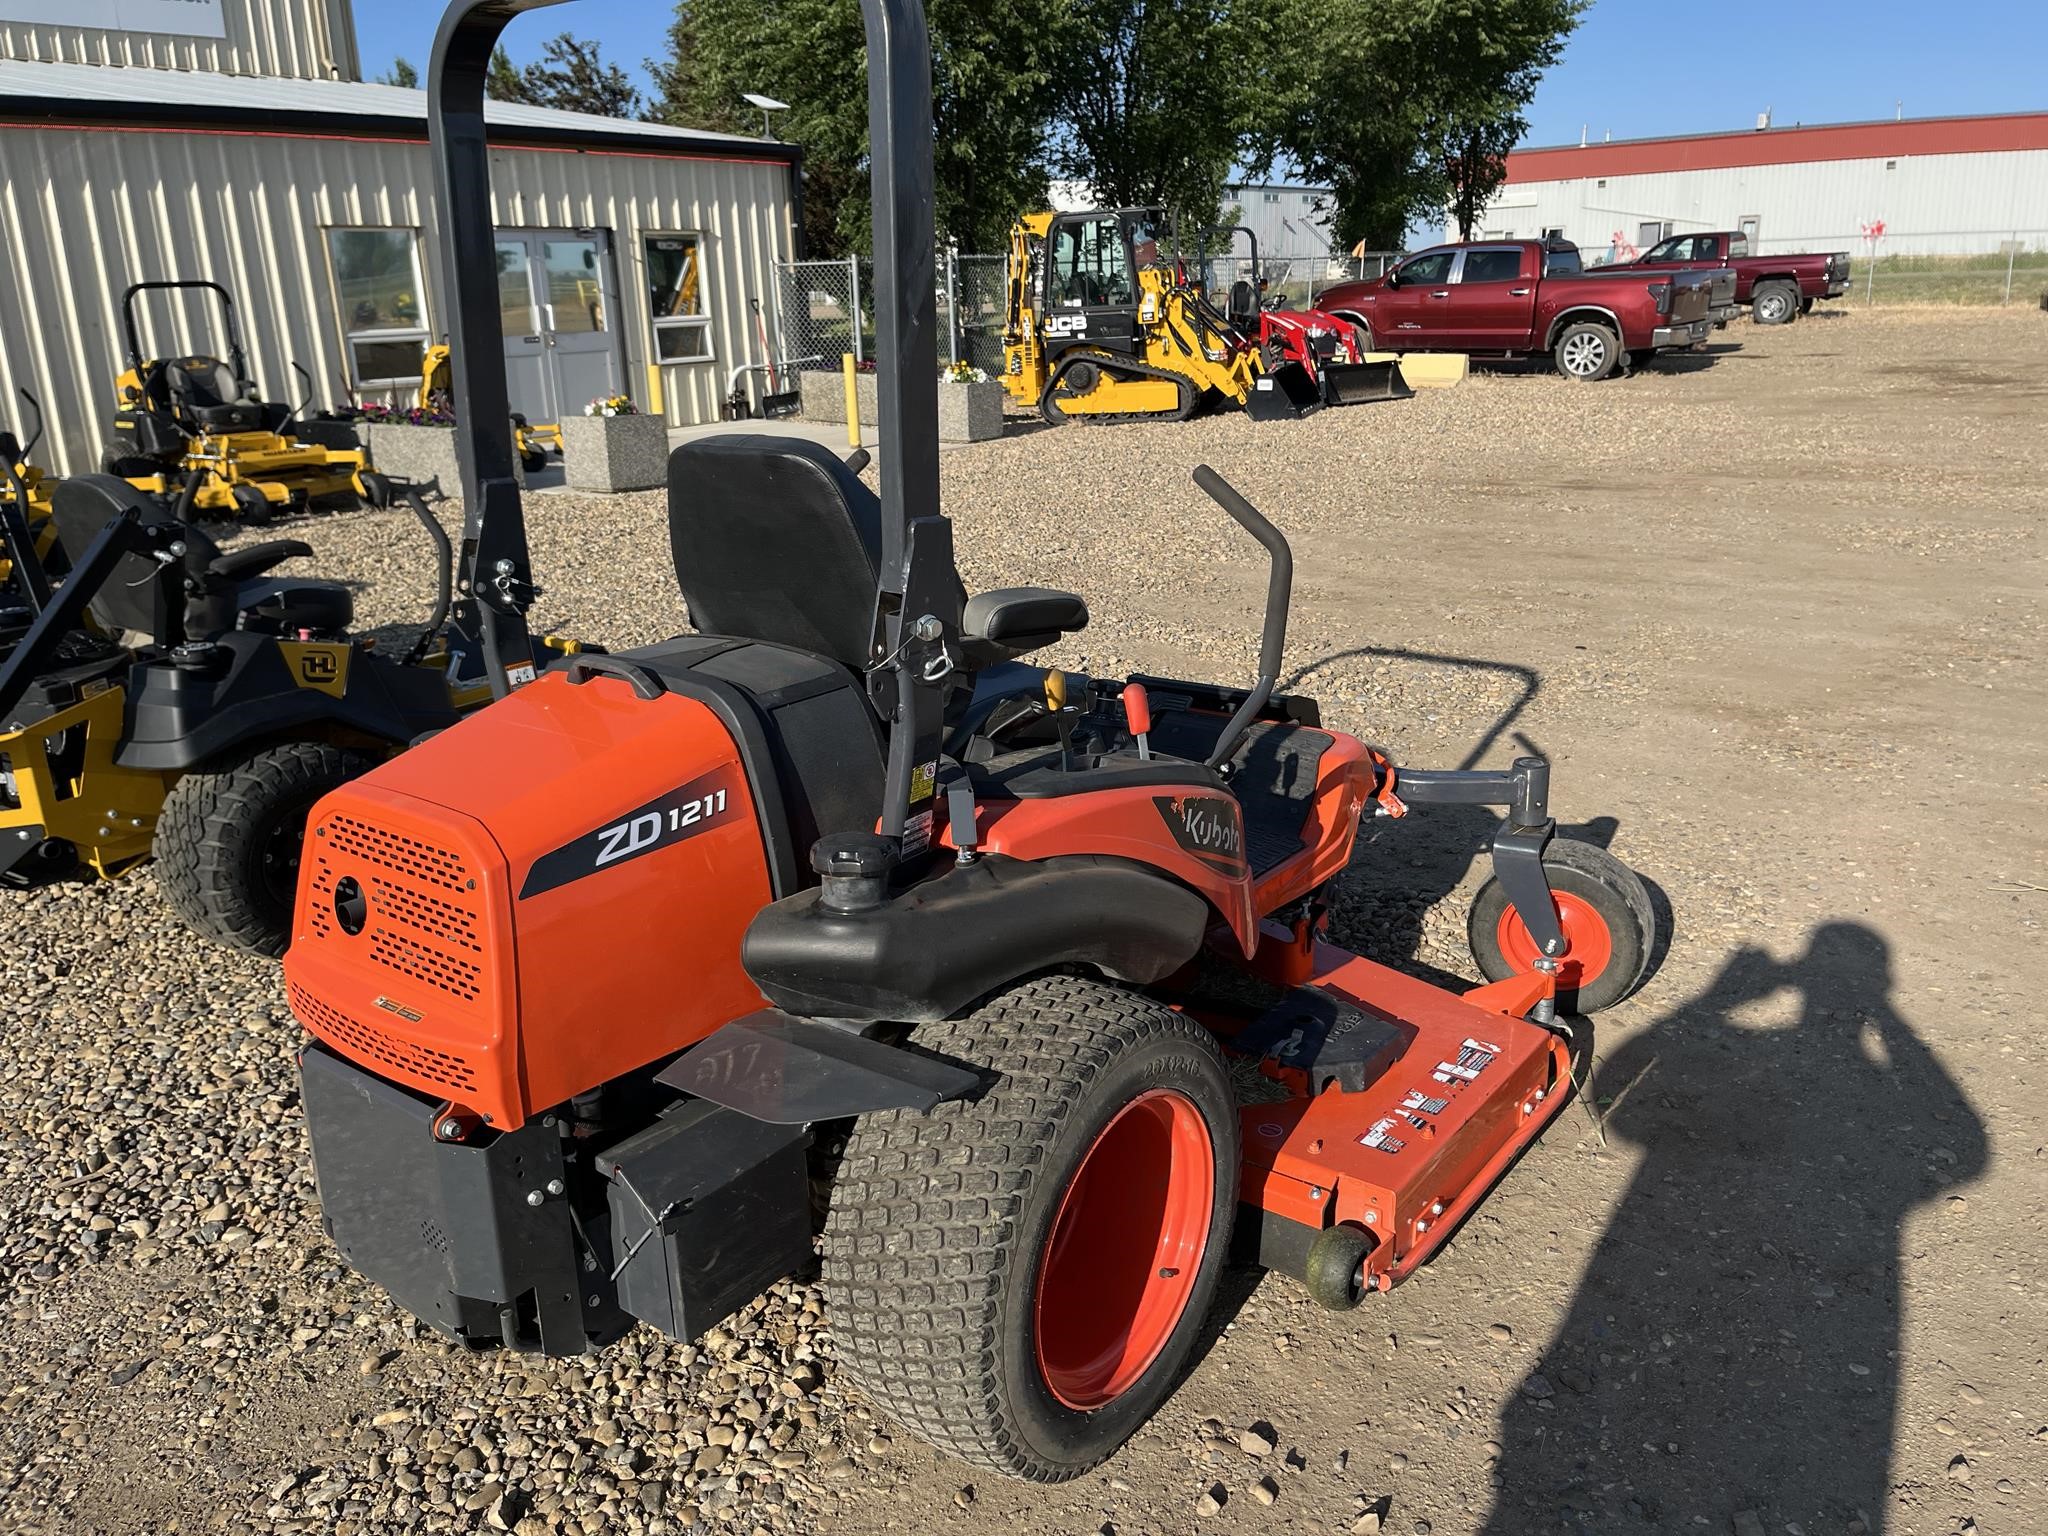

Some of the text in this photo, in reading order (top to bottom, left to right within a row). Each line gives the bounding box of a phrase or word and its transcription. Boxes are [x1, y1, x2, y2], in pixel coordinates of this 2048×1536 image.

[1045, 316, 1087, 332] JCB
[595, 789, 726, 866] ZD 1211
[1185, 808, 1240, 853] Kubota
